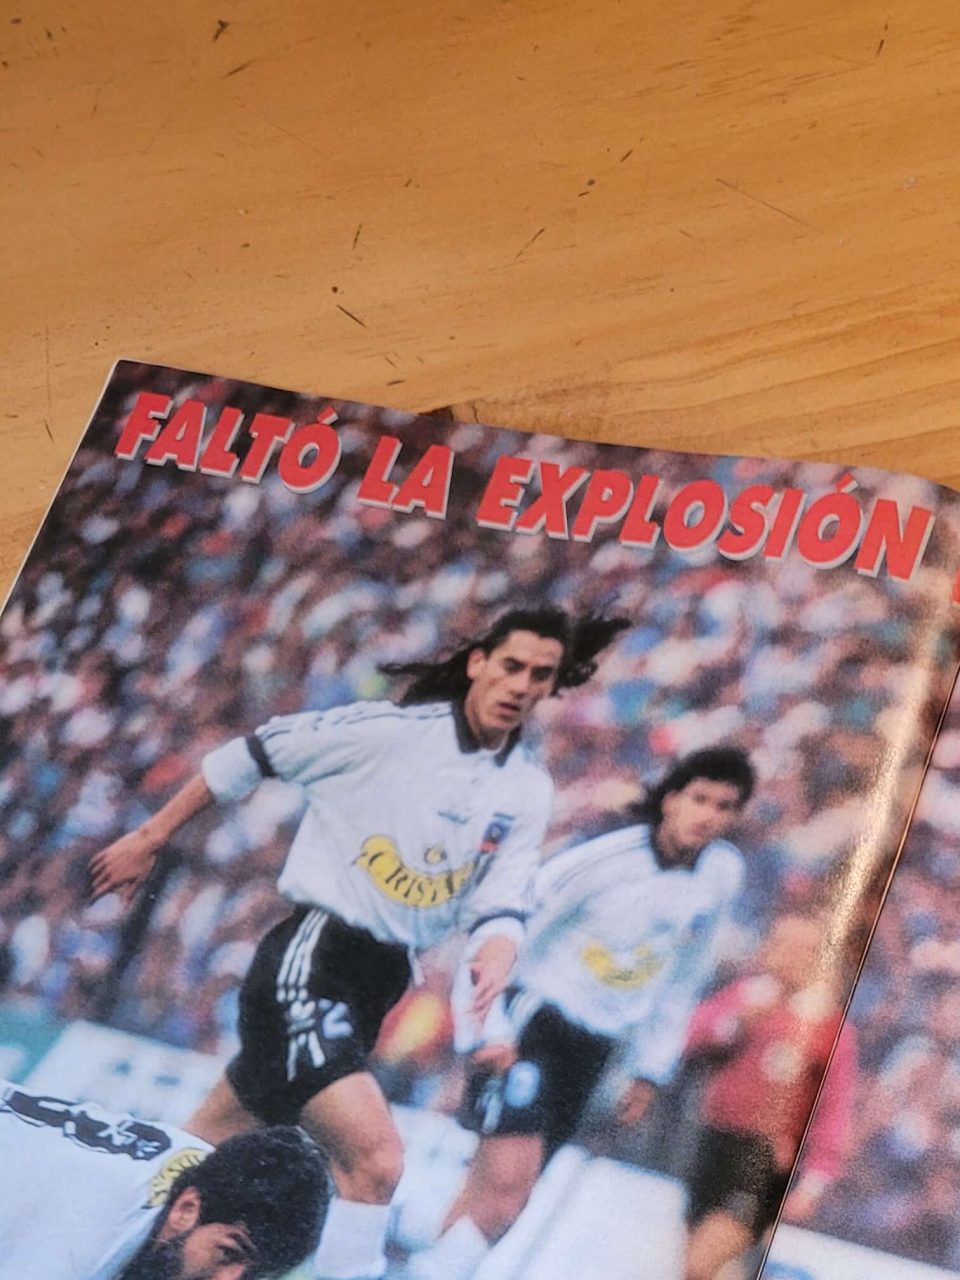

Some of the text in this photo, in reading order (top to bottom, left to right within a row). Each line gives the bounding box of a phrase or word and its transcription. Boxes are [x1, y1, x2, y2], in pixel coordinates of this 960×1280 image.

[114, 391, 342, 494] FALTÓ
[356, 437, 455, 520] LA
[476, 453, 936, 582] EXPLOSIÓN
